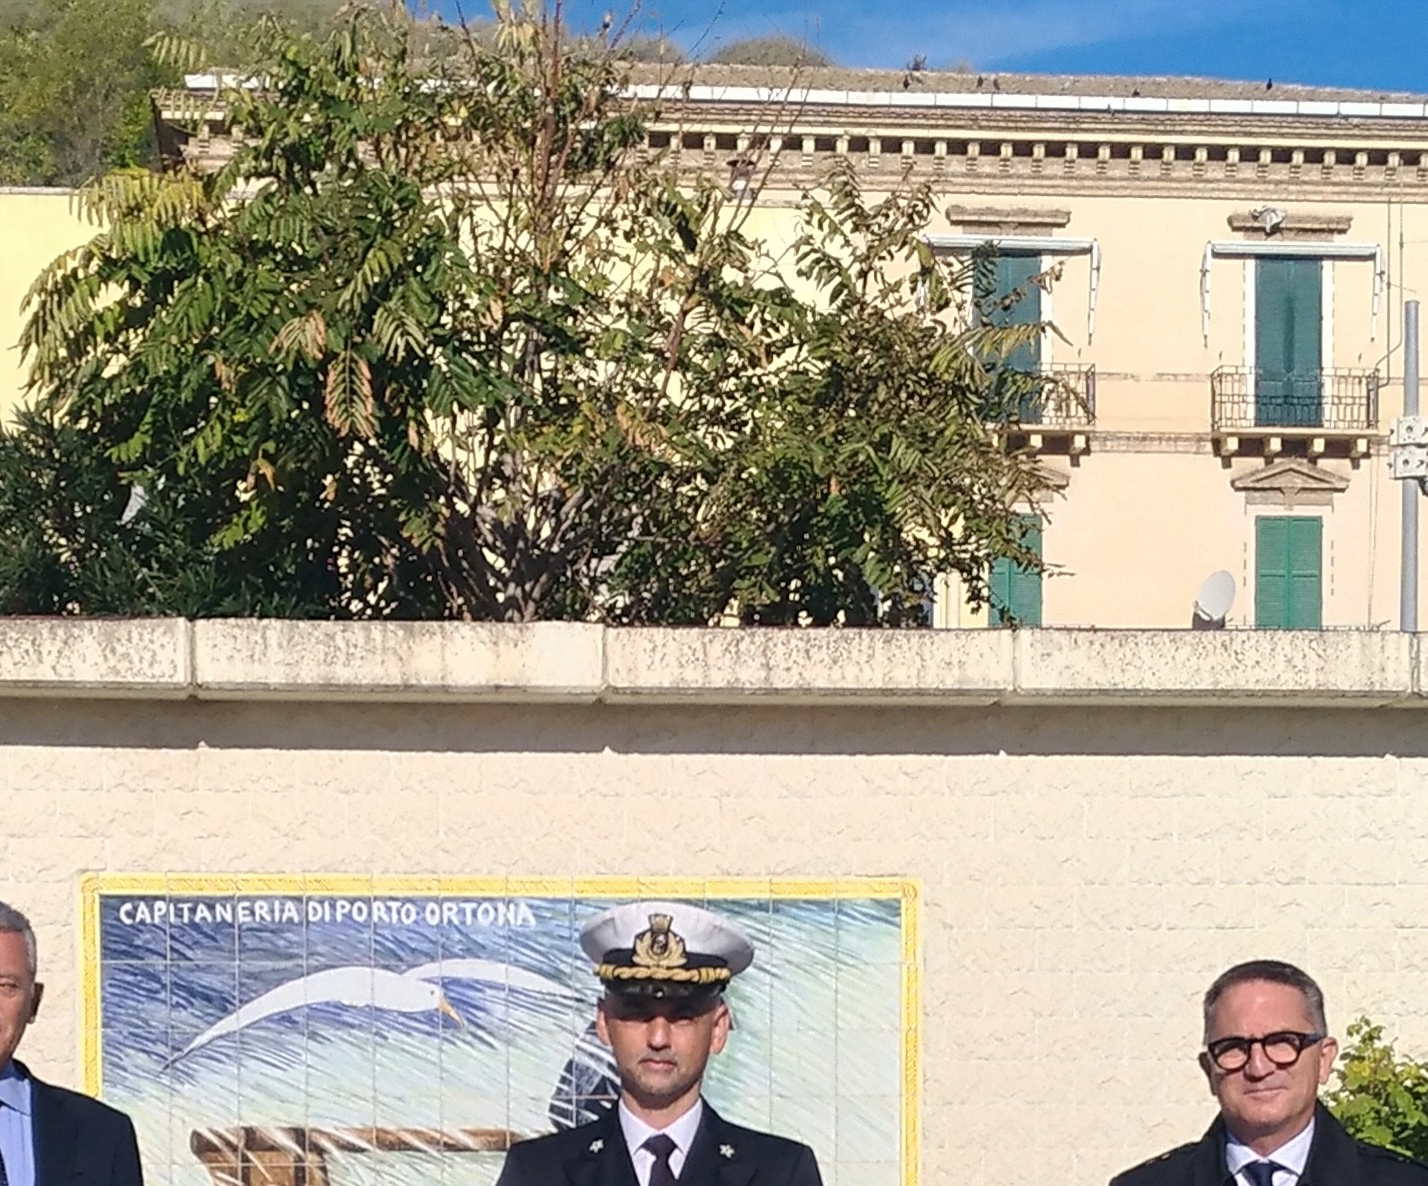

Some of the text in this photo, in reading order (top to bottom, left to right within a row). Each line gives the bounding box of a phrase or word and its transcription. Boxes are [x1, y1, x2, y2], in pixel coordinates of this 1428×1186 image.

[119, 900, 538, 926] CAPITANERIA DI PORTO ORTONA
